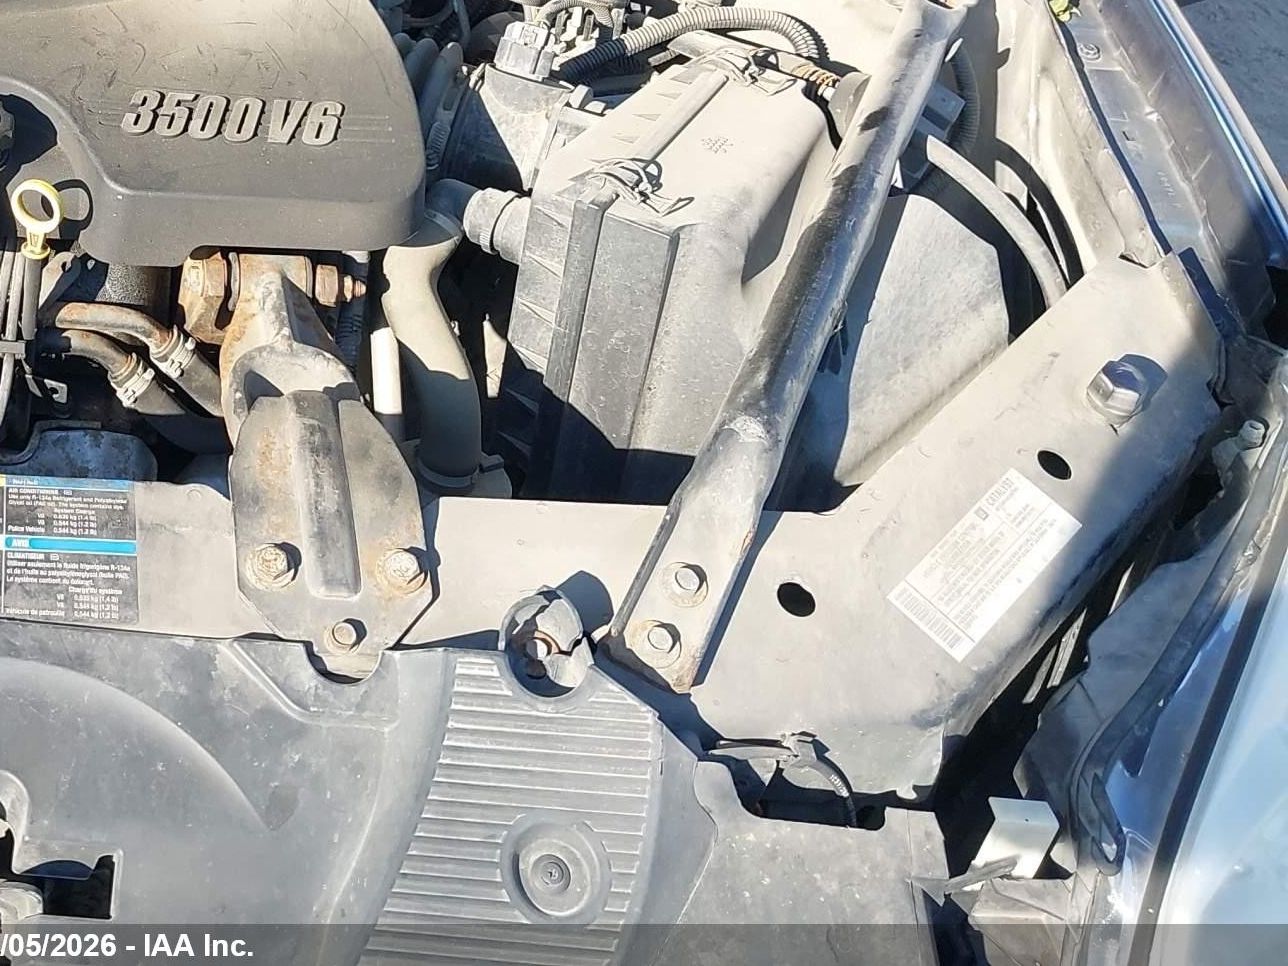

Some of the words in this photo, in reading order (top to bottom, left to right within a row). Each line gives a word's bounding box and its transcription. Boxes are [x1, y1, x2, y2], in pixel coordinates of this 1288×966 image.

[120, 89, 264, 143] 3500
[267, 99, 346, 147] V6
[985, 477, 1015, 507] CATALYST
